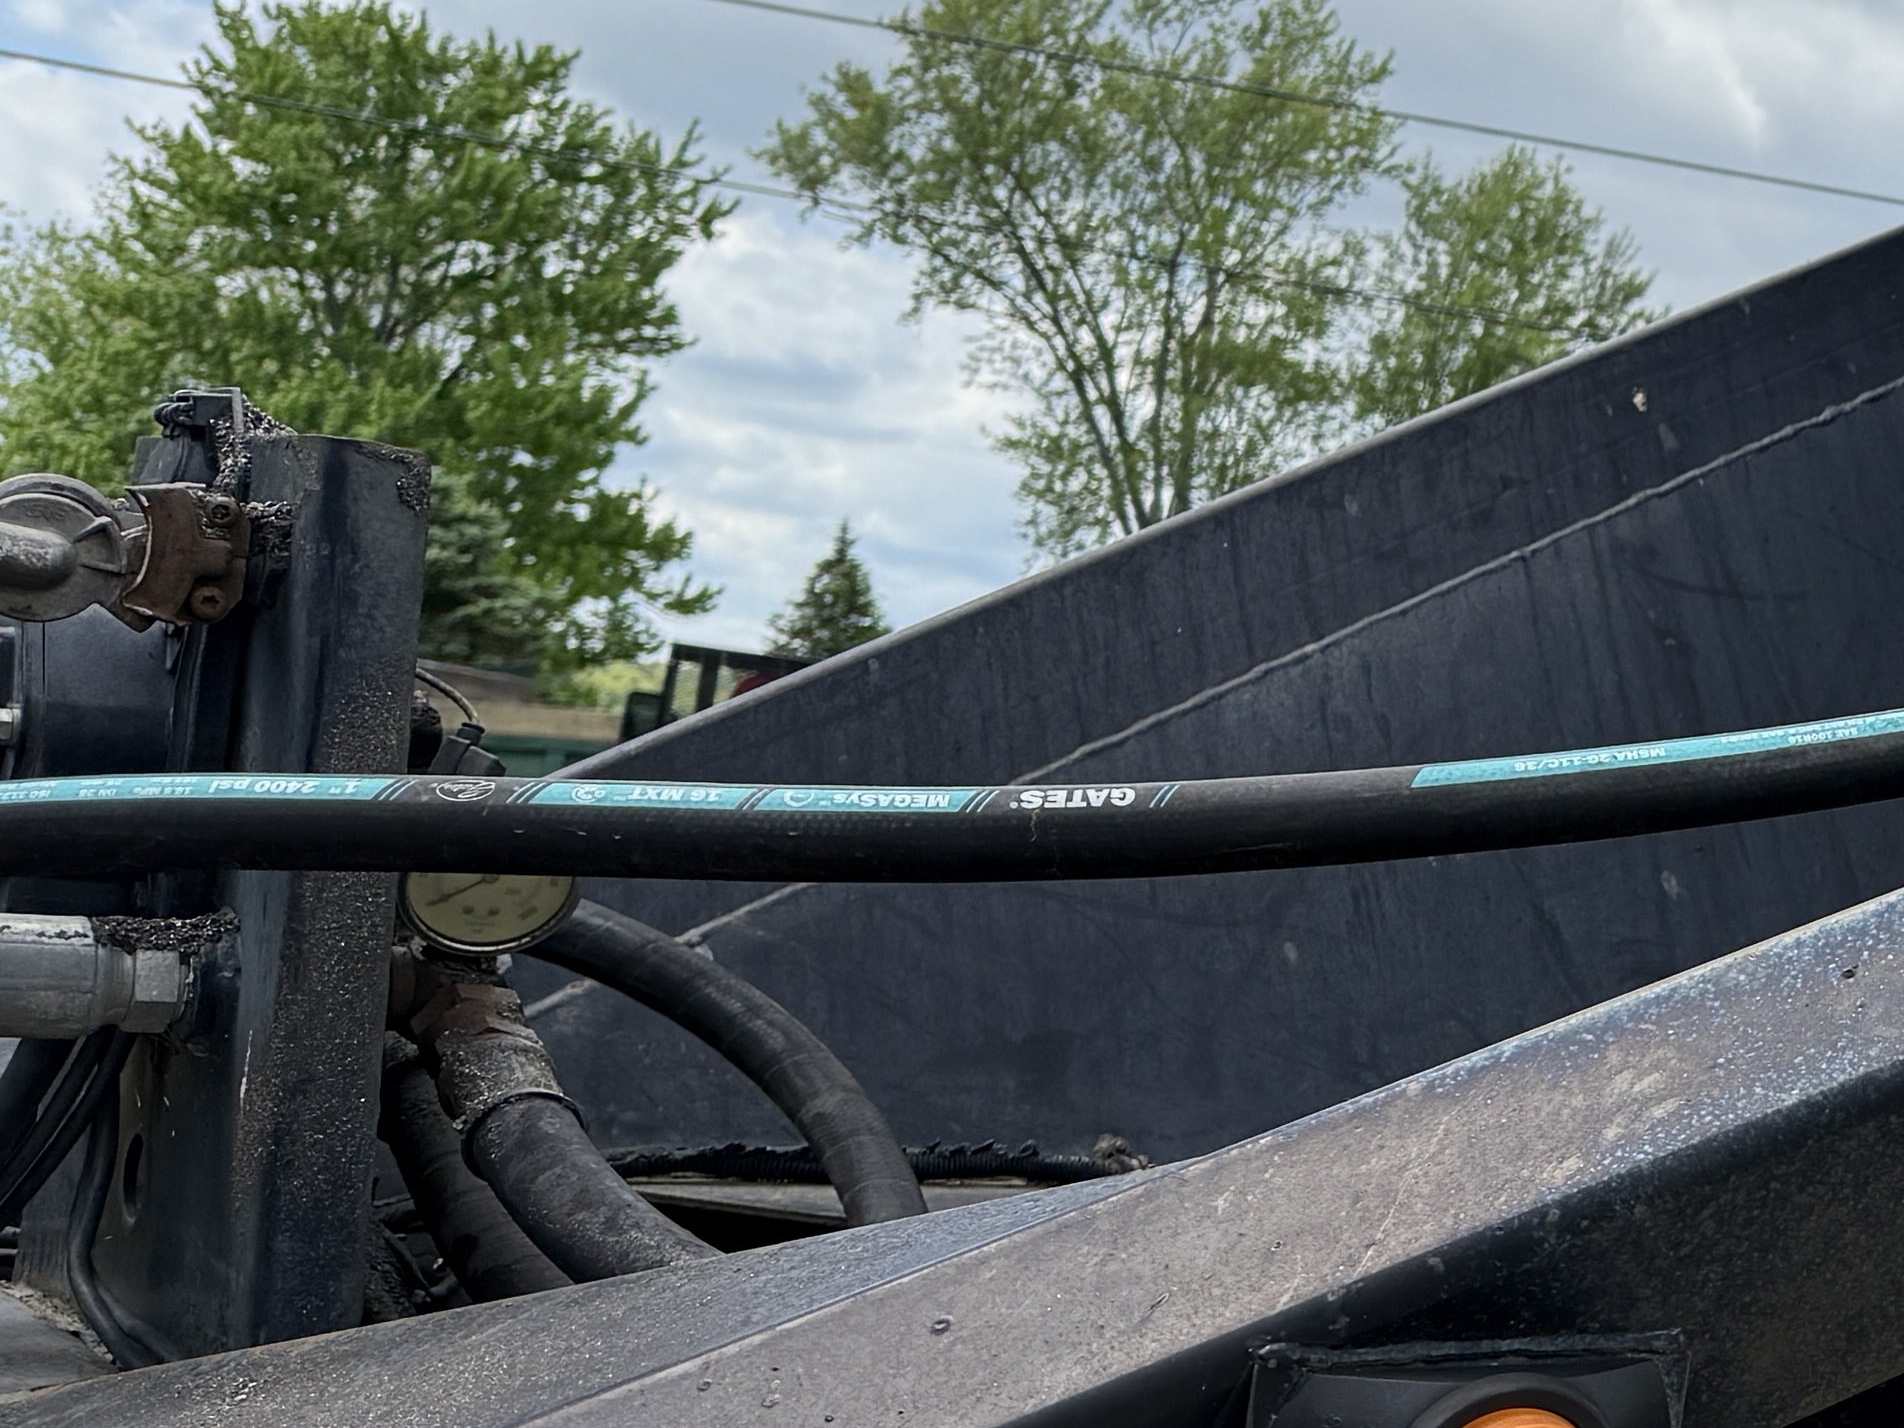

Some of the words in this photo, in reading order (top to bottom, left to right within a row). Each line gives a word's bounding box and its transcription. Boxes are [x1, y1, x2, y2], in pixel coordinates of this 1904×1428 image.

[1834, 727, 1859, 737] SAE
[1616, 746, 1666, 761] MSHA
[208, 779, 250, 793] psi
[250, 780, 320, 793] 2400
[628, 787, 684, 802] MXT
[691, 790, 719, 802] 16
[1018, 788, 1136, 809] GATES
